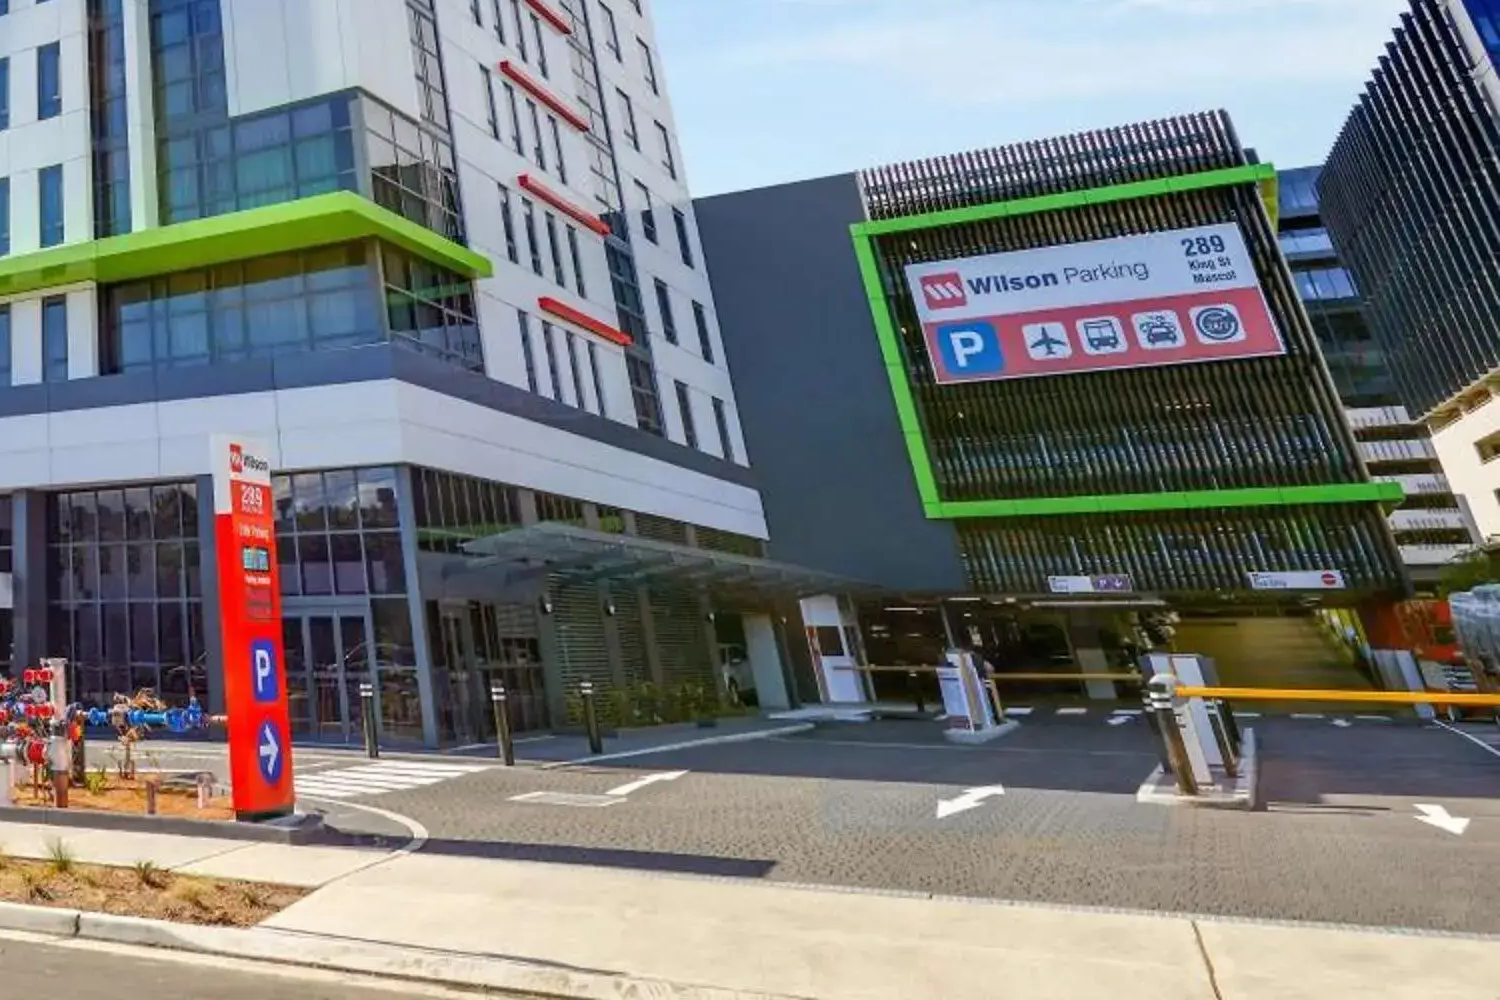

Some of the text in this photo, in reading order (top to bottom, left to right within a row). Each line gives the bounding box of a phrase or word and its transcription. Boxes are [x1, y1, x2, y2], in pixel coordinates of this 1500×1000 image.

[1181, 234, 1225, 257] 289
[967, 260, 1150, 295] Wilson Parking
[1188, 256, 1232, 271] King St
[1192, 270, 1238, 284] Mascot
[949, 331, 983, 368] P
[254, 649, 270, 694] P
